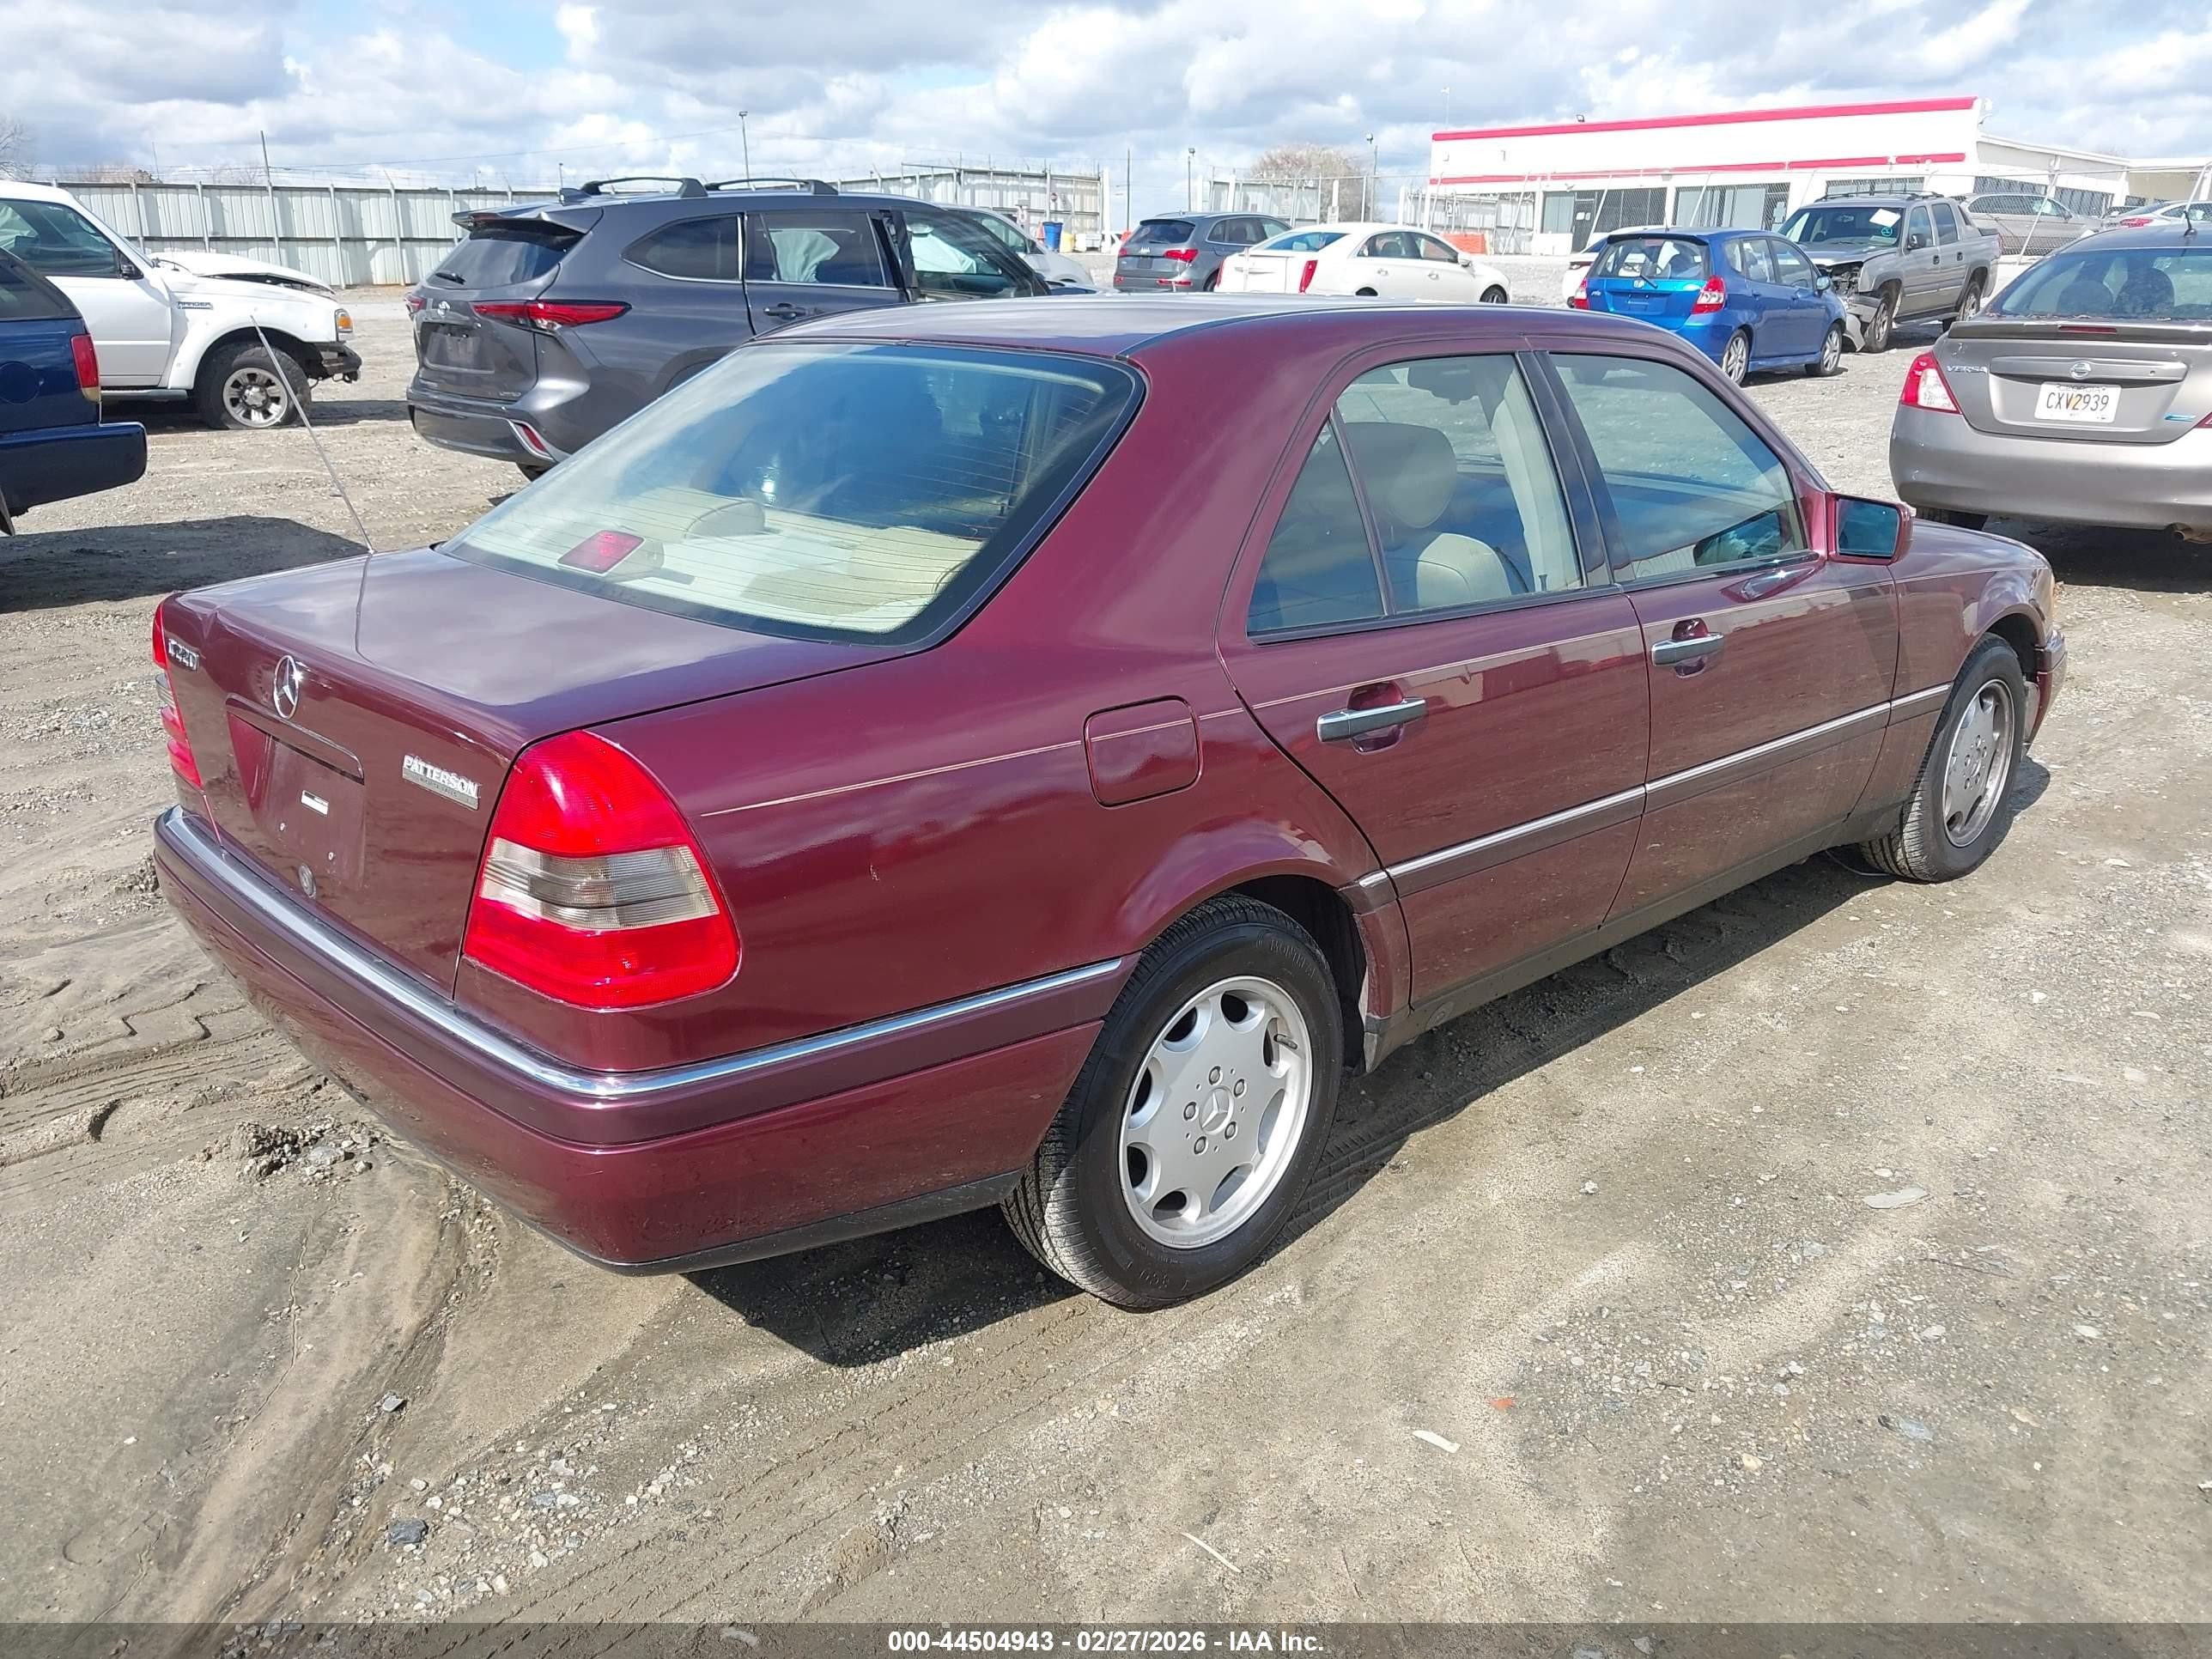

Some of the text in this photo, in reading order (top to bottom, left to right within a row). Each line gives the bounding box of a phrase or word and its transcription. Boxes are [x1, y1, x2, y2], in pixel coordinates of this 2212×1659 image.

[1947, 365, 1988, 374] VERSA
[2045, 392, 2110, 411] CXV2939
[402, 755, 479, 799] PATTERSON
